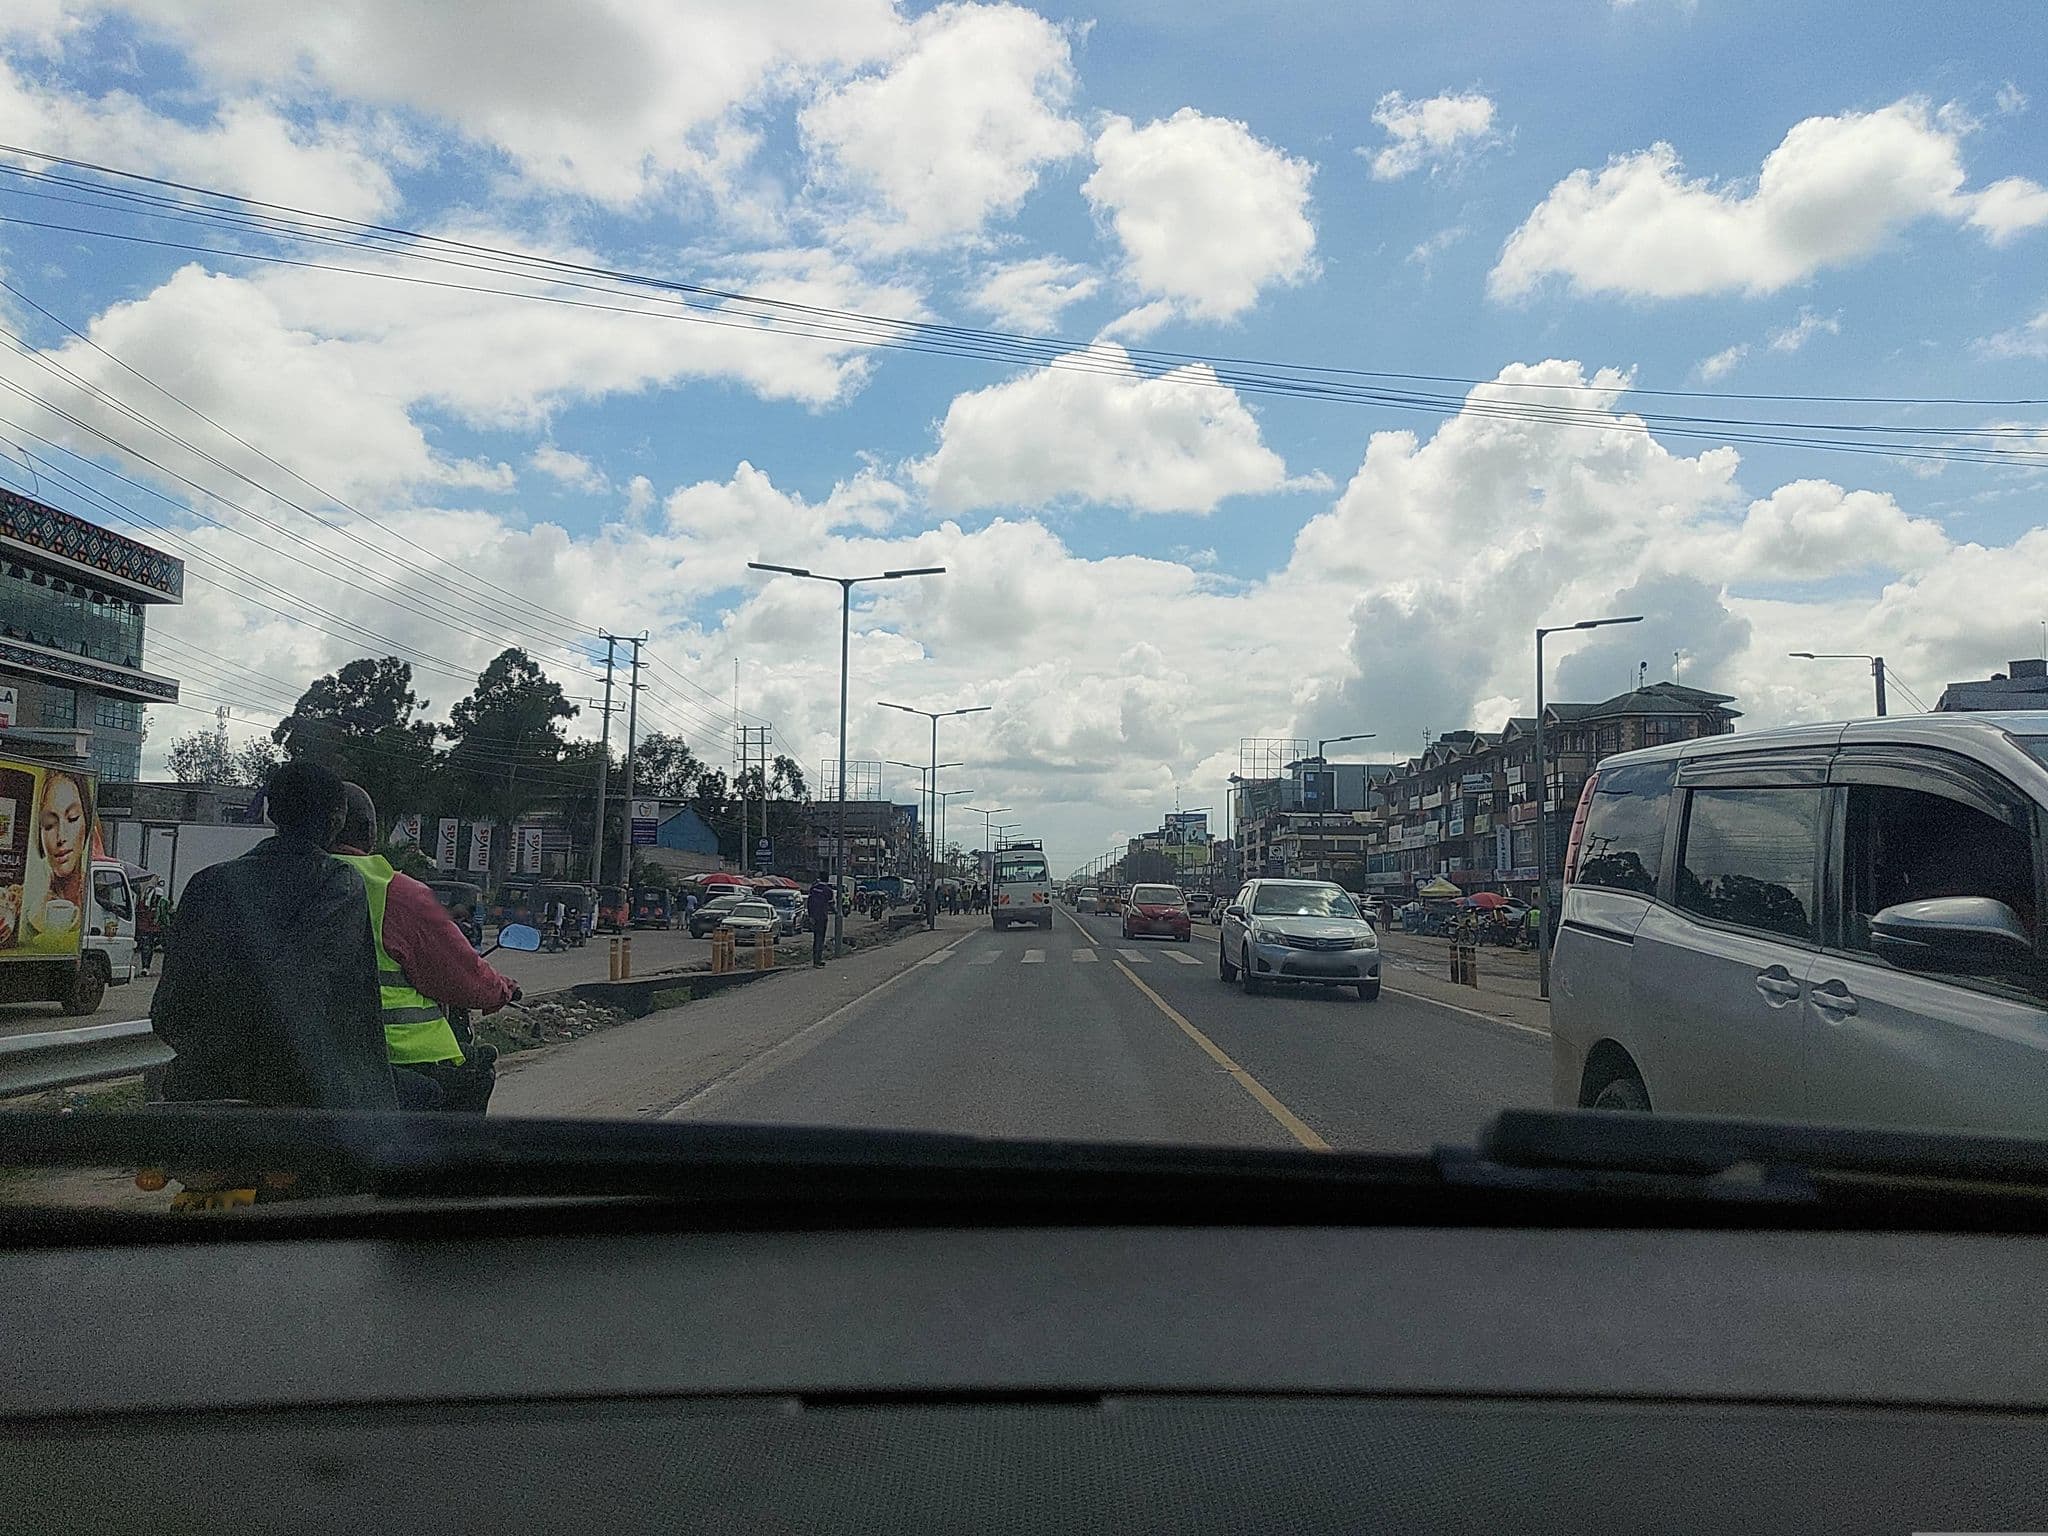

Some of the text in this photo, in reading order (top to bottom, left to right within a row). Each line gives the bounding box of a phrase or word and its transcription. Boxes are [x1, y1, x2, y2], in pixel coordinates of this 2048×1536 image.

[0, 854, 21, 867] SALA
[441, 824, 456, 864] naivas
[474, 828, 490, 866] naivas
[527, 834, 541, 868] naivas
